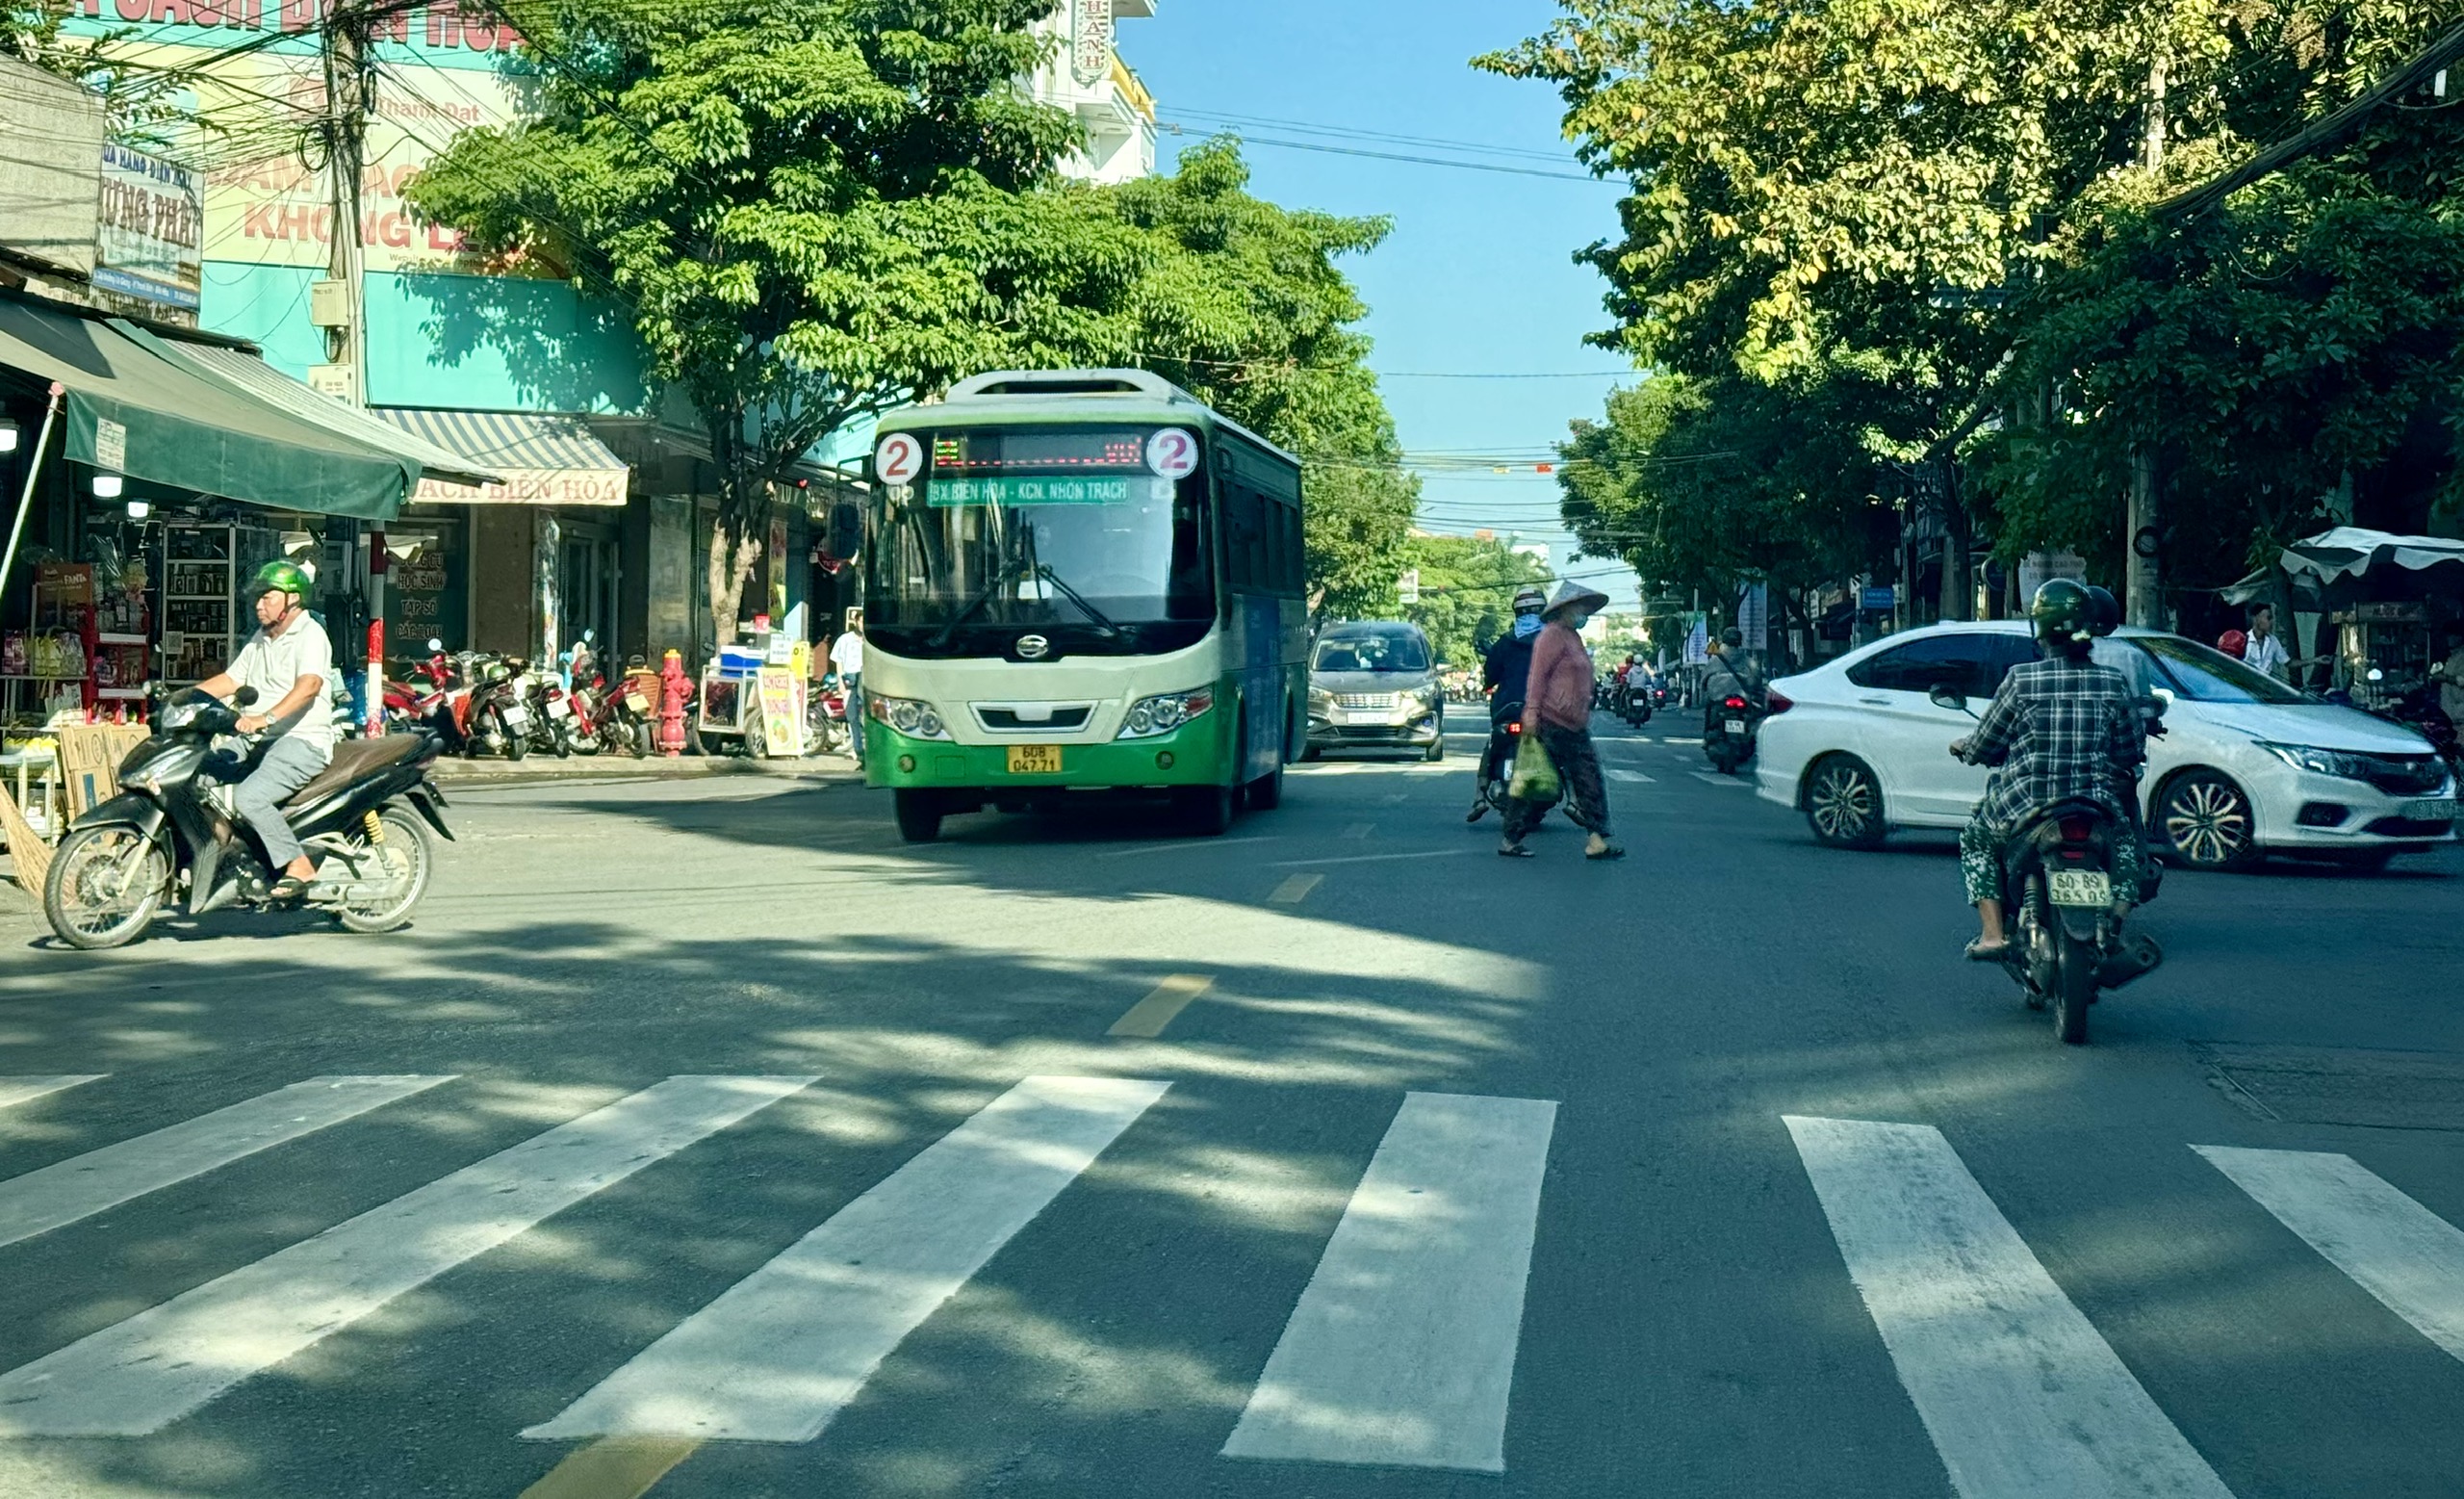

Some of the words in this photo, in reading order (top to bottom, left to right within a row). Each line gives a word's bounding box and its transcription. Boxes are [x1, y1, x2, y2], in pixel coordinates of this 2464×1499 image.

[886, 440, 910, 477] 2
[1160, 435, 1189, 469] 2
[488, 474, 552, 500] BIÊN
[562, 475, 618, 501] HÒA
[1018, 482, 1045, 500] KCN.
[1022, 746, 1046, 759] 60B
[1014, 759, 1055, 772] 047.71
